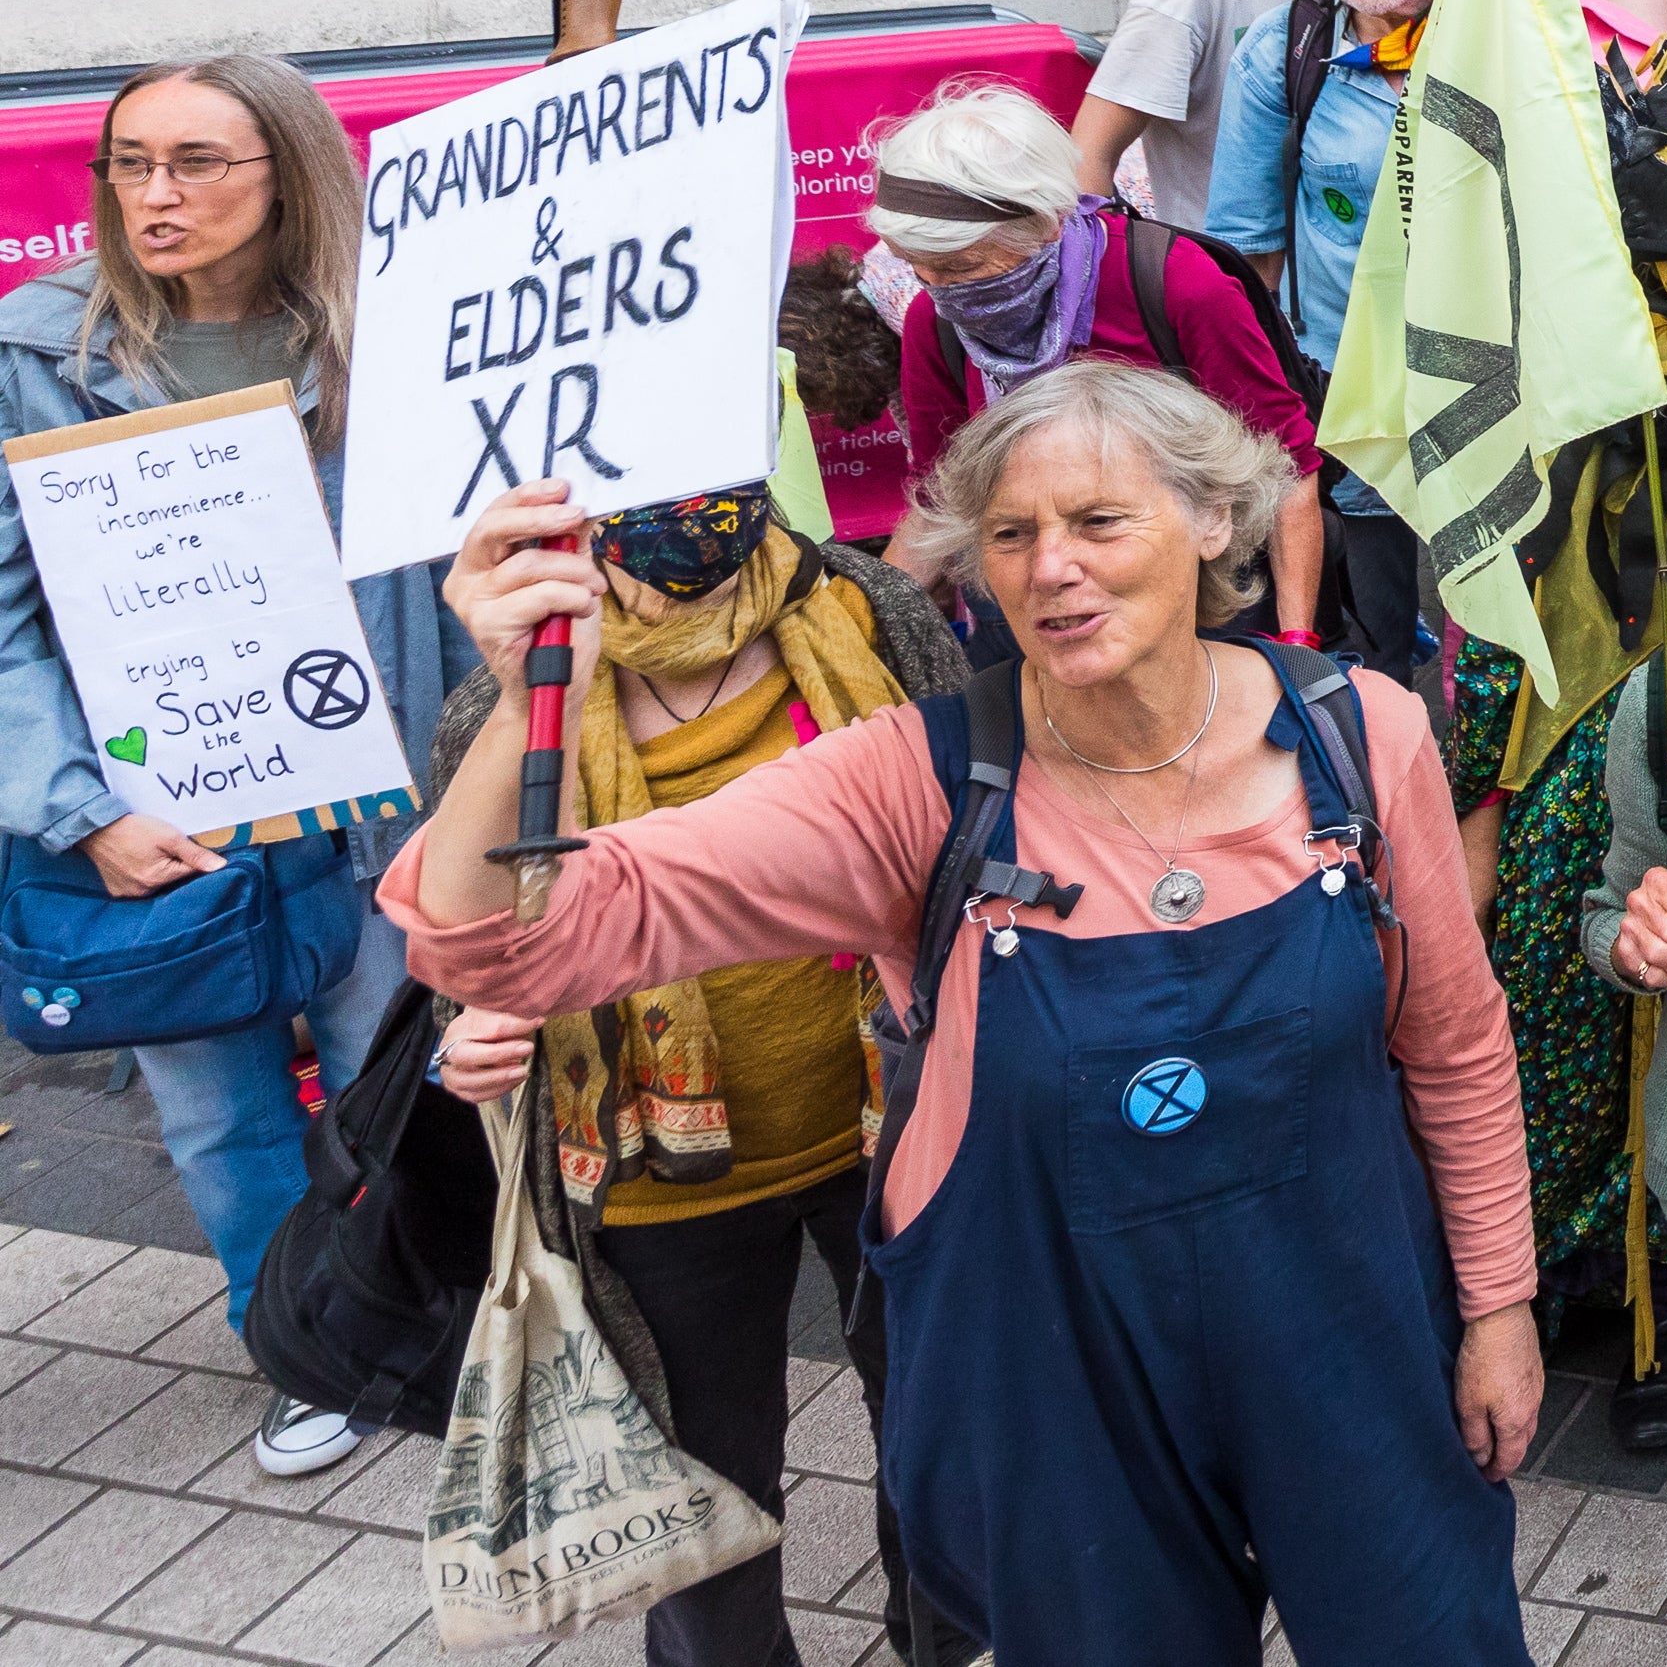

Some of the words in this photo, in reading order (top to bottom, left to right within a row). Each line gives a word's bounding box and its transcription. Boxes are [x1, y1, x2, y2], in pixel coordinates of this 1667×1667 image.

[367, 27, 778, 277] GRANDPARENTS
[0, 221, 91, 263] self
[531, 196, 564, 266] &
[445, 225, 702, 382] ELDERS
[451, 363, 632, 519] XR
[838, 428, 902, 450] ticke
[40, 470, 118, 507] Sorry
[137, 450, 176, 483] for
[194, 442, 241, 471] the
[97, 492, 271, 535] inconvenience...
[135, 534, 202, 561] we're
[103, 561, 267, 618] literally
[125, 652, 207, 687] trying
[231, 638, 261, 660] to
[155, 688, 272, 736] Save
[202, 728, 243, 752] the
[157, 744, 296, 802] World
[560, 1486, 717, 1574] BOOKS
